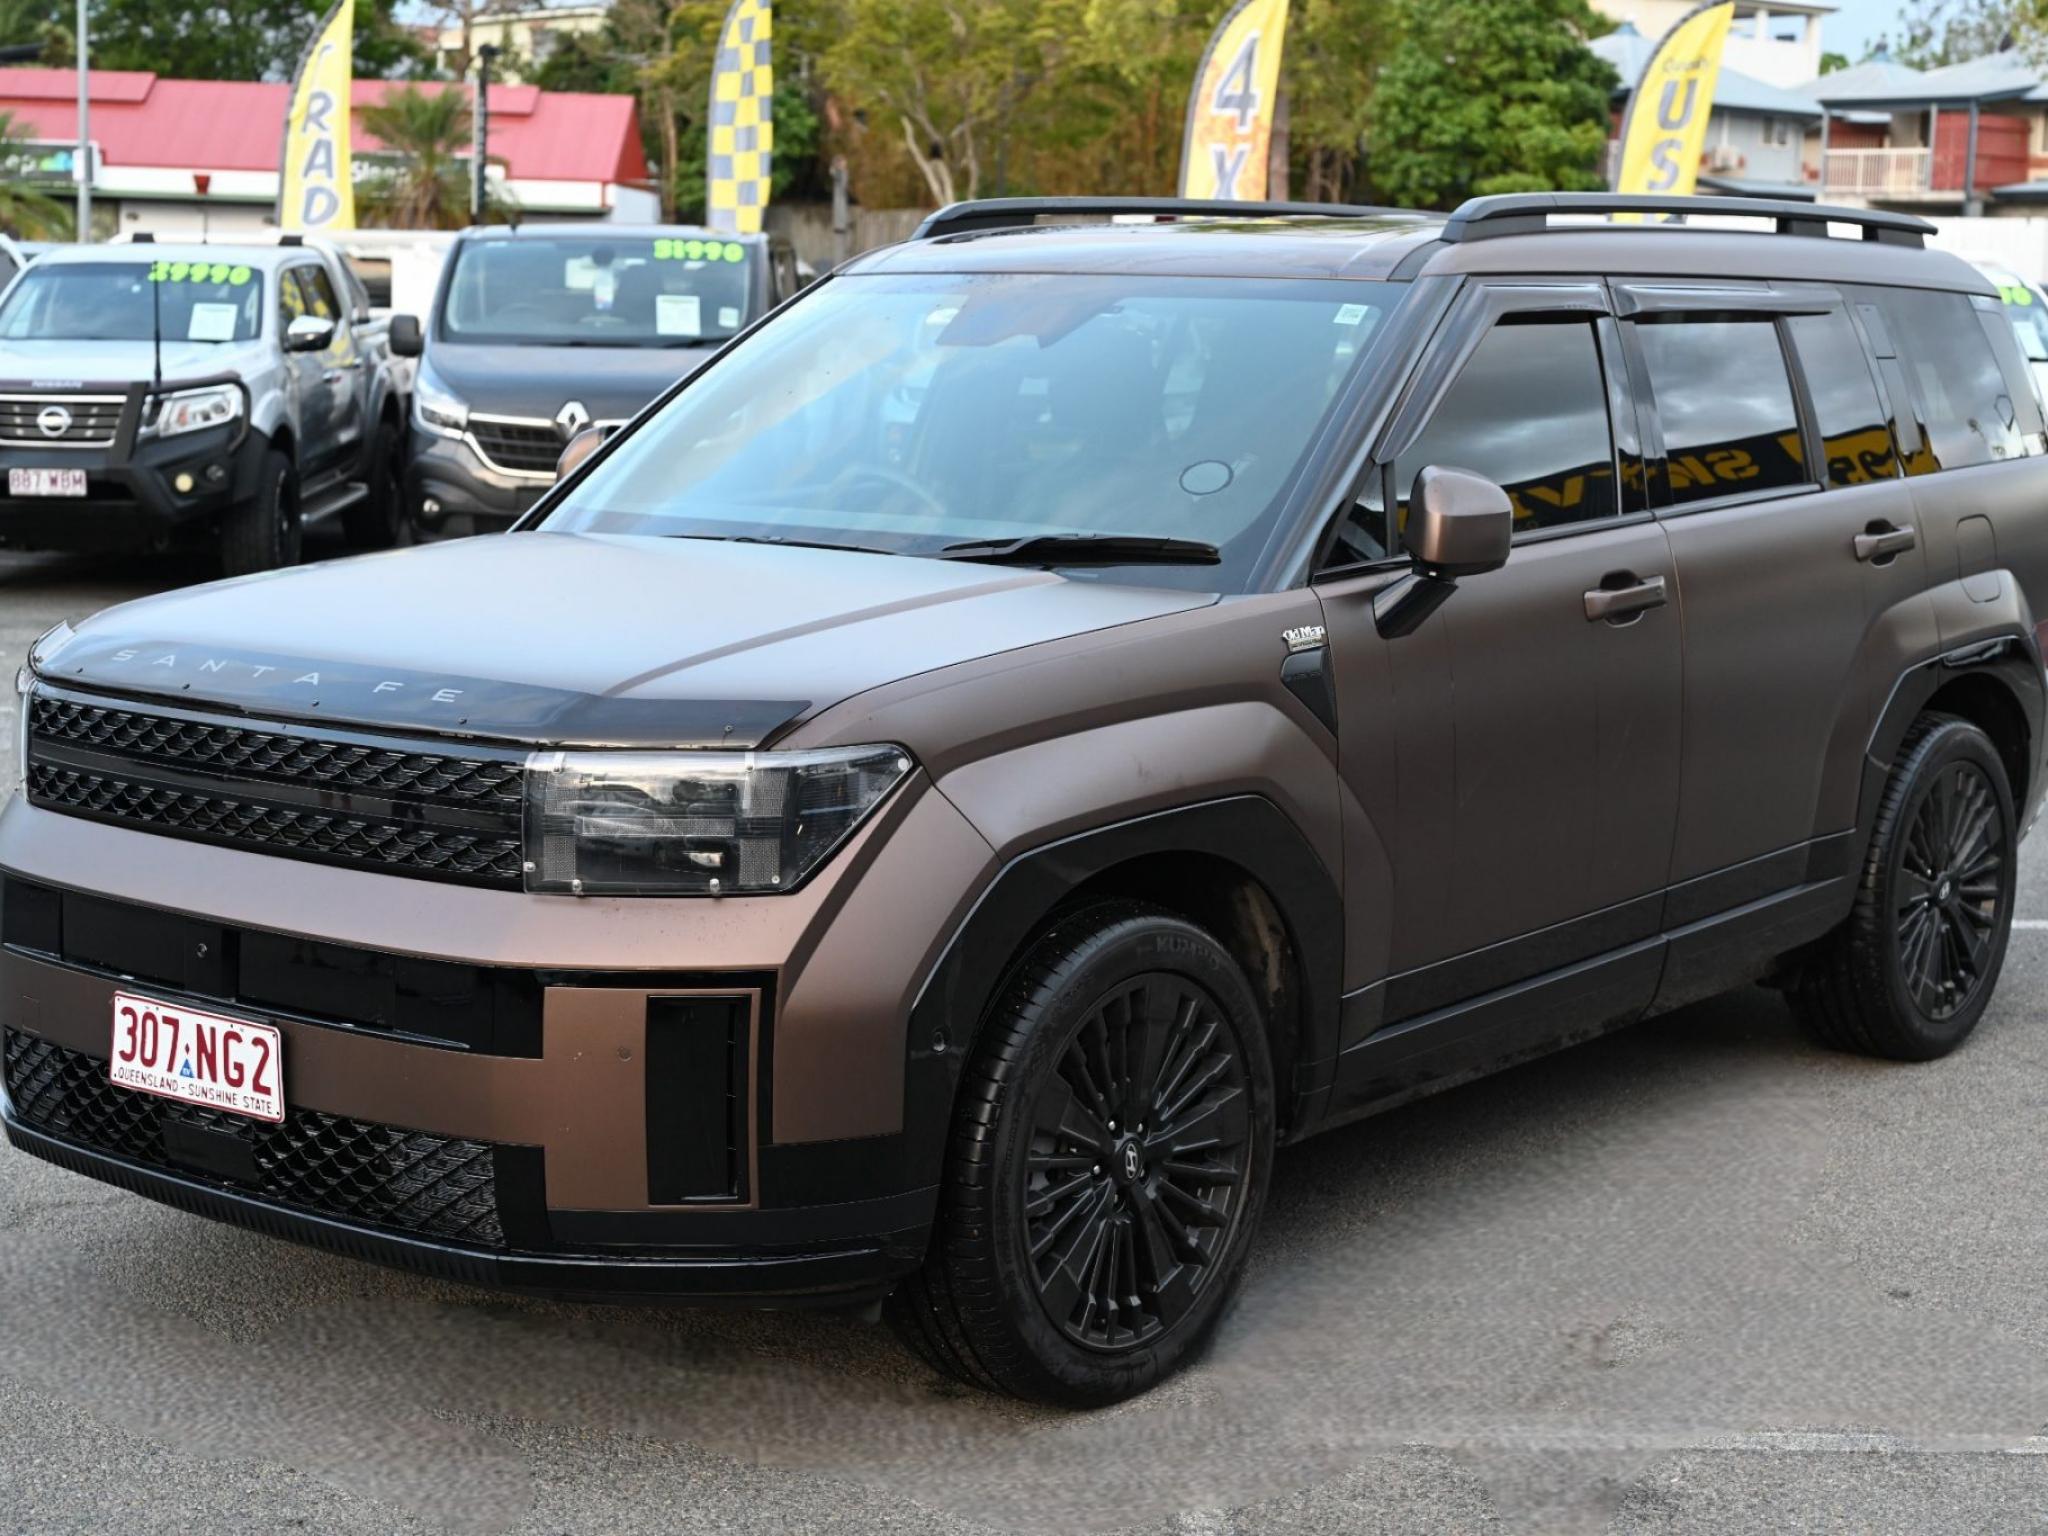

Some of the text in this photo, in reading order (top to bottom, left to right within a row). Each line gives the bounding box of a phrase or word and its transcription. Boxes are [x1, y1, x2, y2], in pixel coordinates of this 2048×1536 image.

[112, 649, 464, 703] SANTA FE
[118, 1066, 178, 1092] QUEENSLAND
[188, 1083, 238, 1106] SUNSHINE
[243, 1095, 273, 1115] STATE
